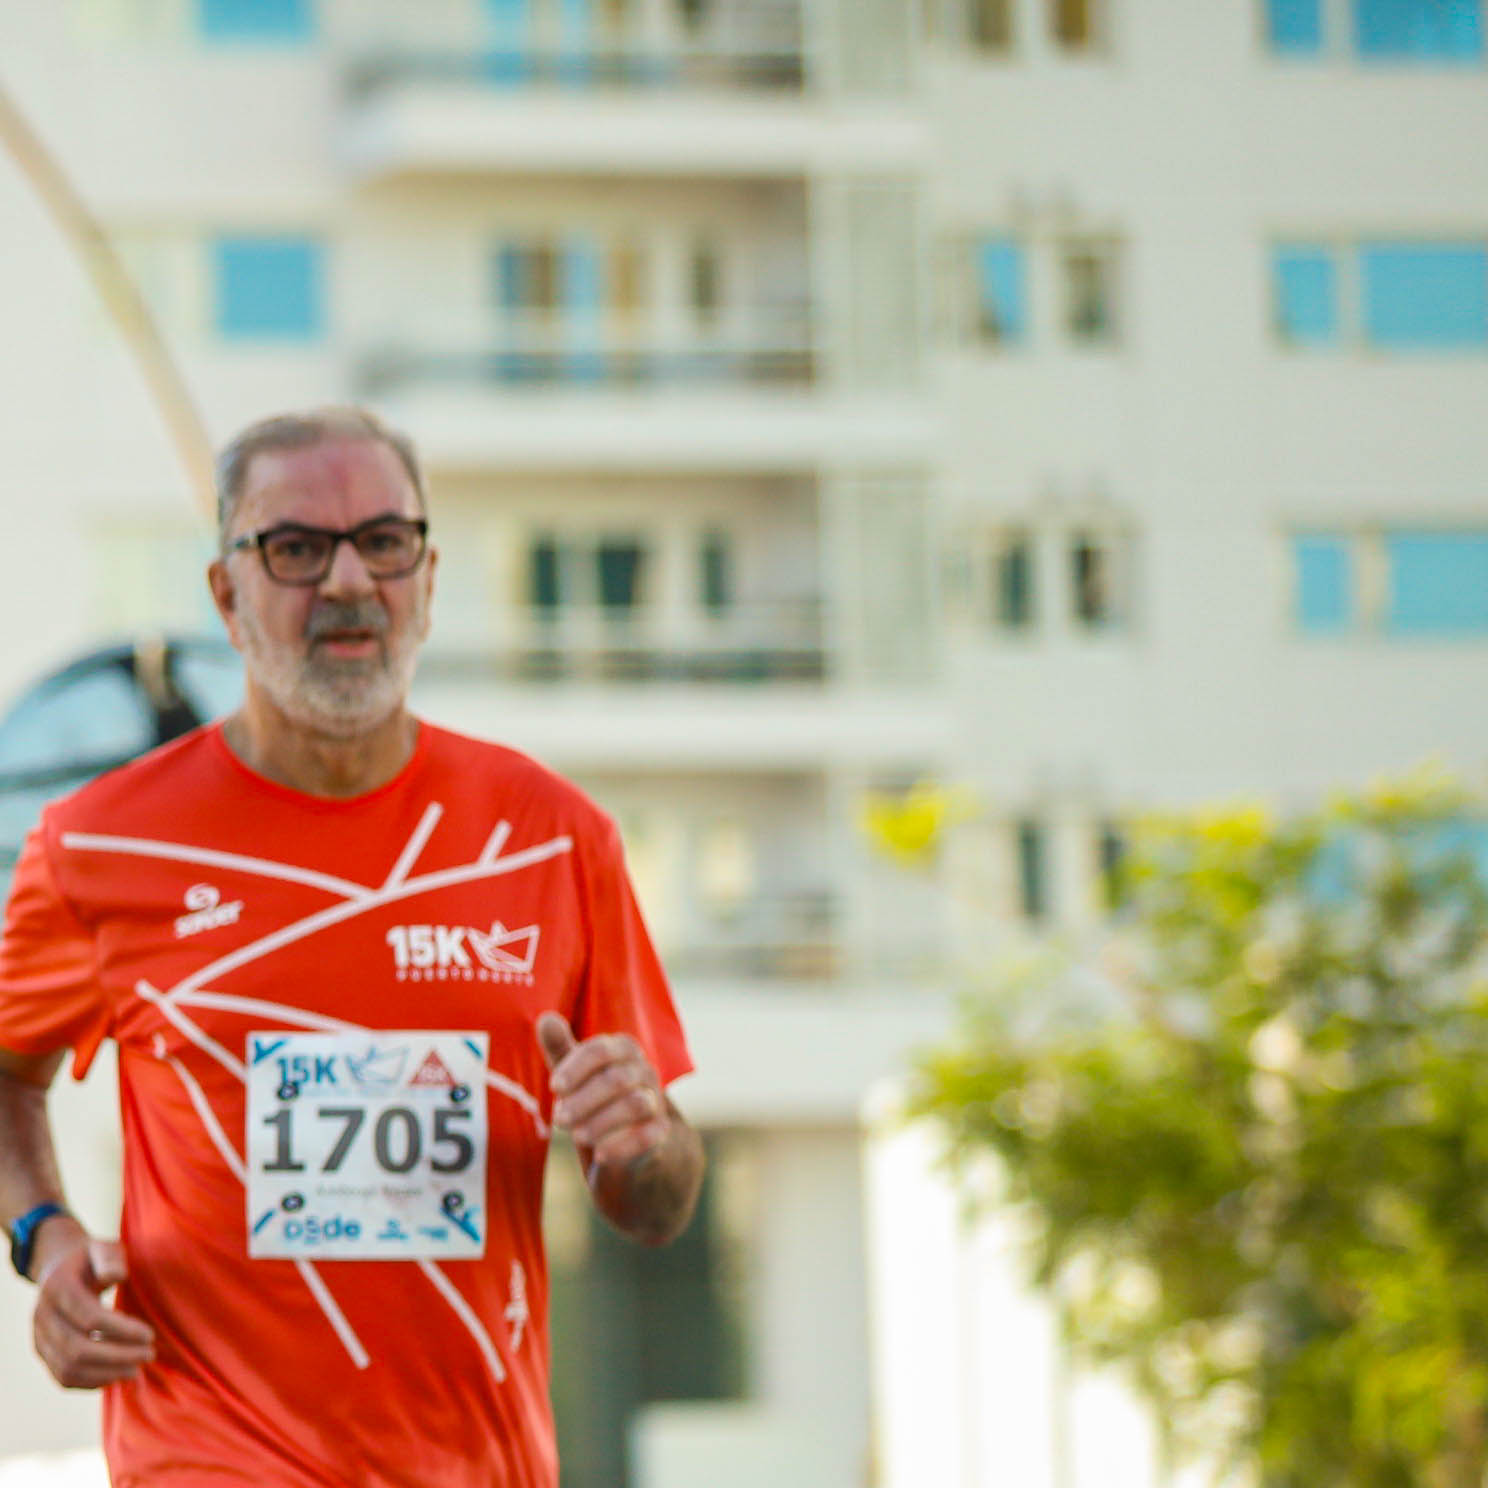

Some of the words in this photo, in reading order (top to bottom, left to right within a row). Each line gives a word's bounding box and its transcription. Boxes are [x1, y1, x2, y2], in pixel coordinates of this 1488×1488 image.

[386, 924, 473, 968] 15K
[276, 1055, 337, 1085] 15K
[262, 1107, 475, 1174] 1705
